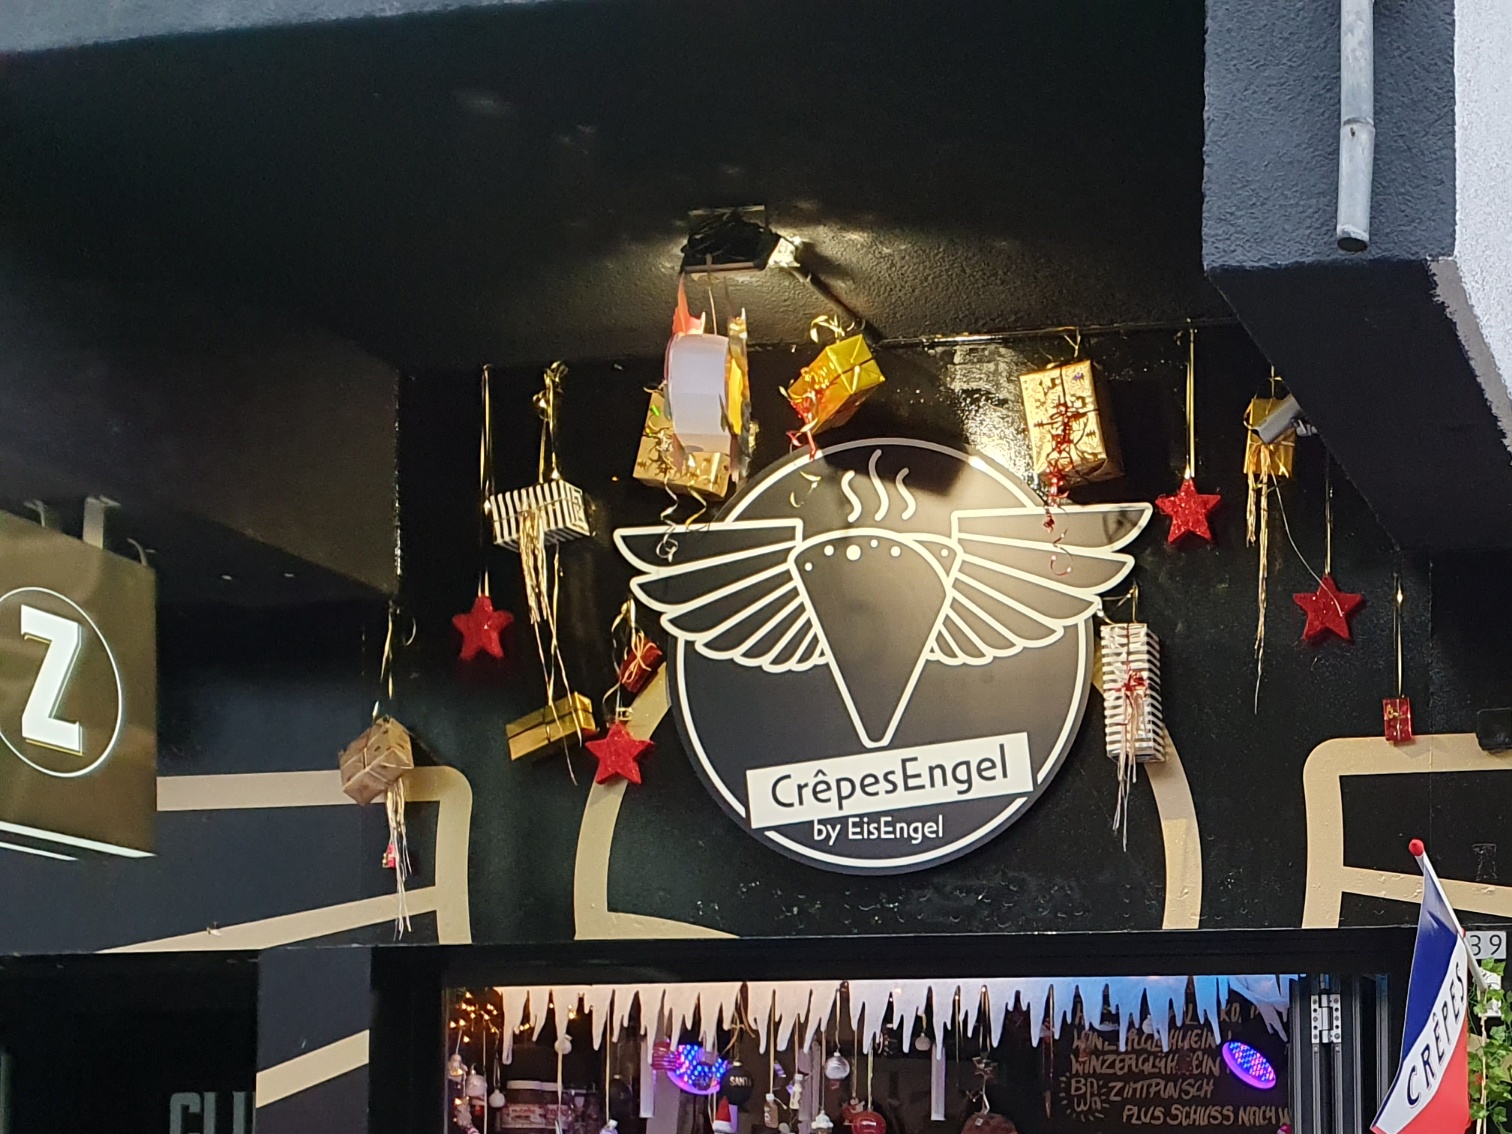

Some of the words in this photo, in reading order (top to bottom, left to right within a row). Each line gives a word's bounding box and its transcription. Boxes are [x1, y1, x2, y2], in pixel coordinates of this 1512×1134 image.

[21, 605, 83, 754] Z
[771, 743, 1009, 811] CrêpesEngel
[813, 818, 841, 846] by
[847, 814, 944, 845] EisEngel
[1469, 934, 1502, 956] 39
[1407, 960, 1466, 1110] CRÊPES
[1166, 1105, 1234, 1126] SCHUSS
